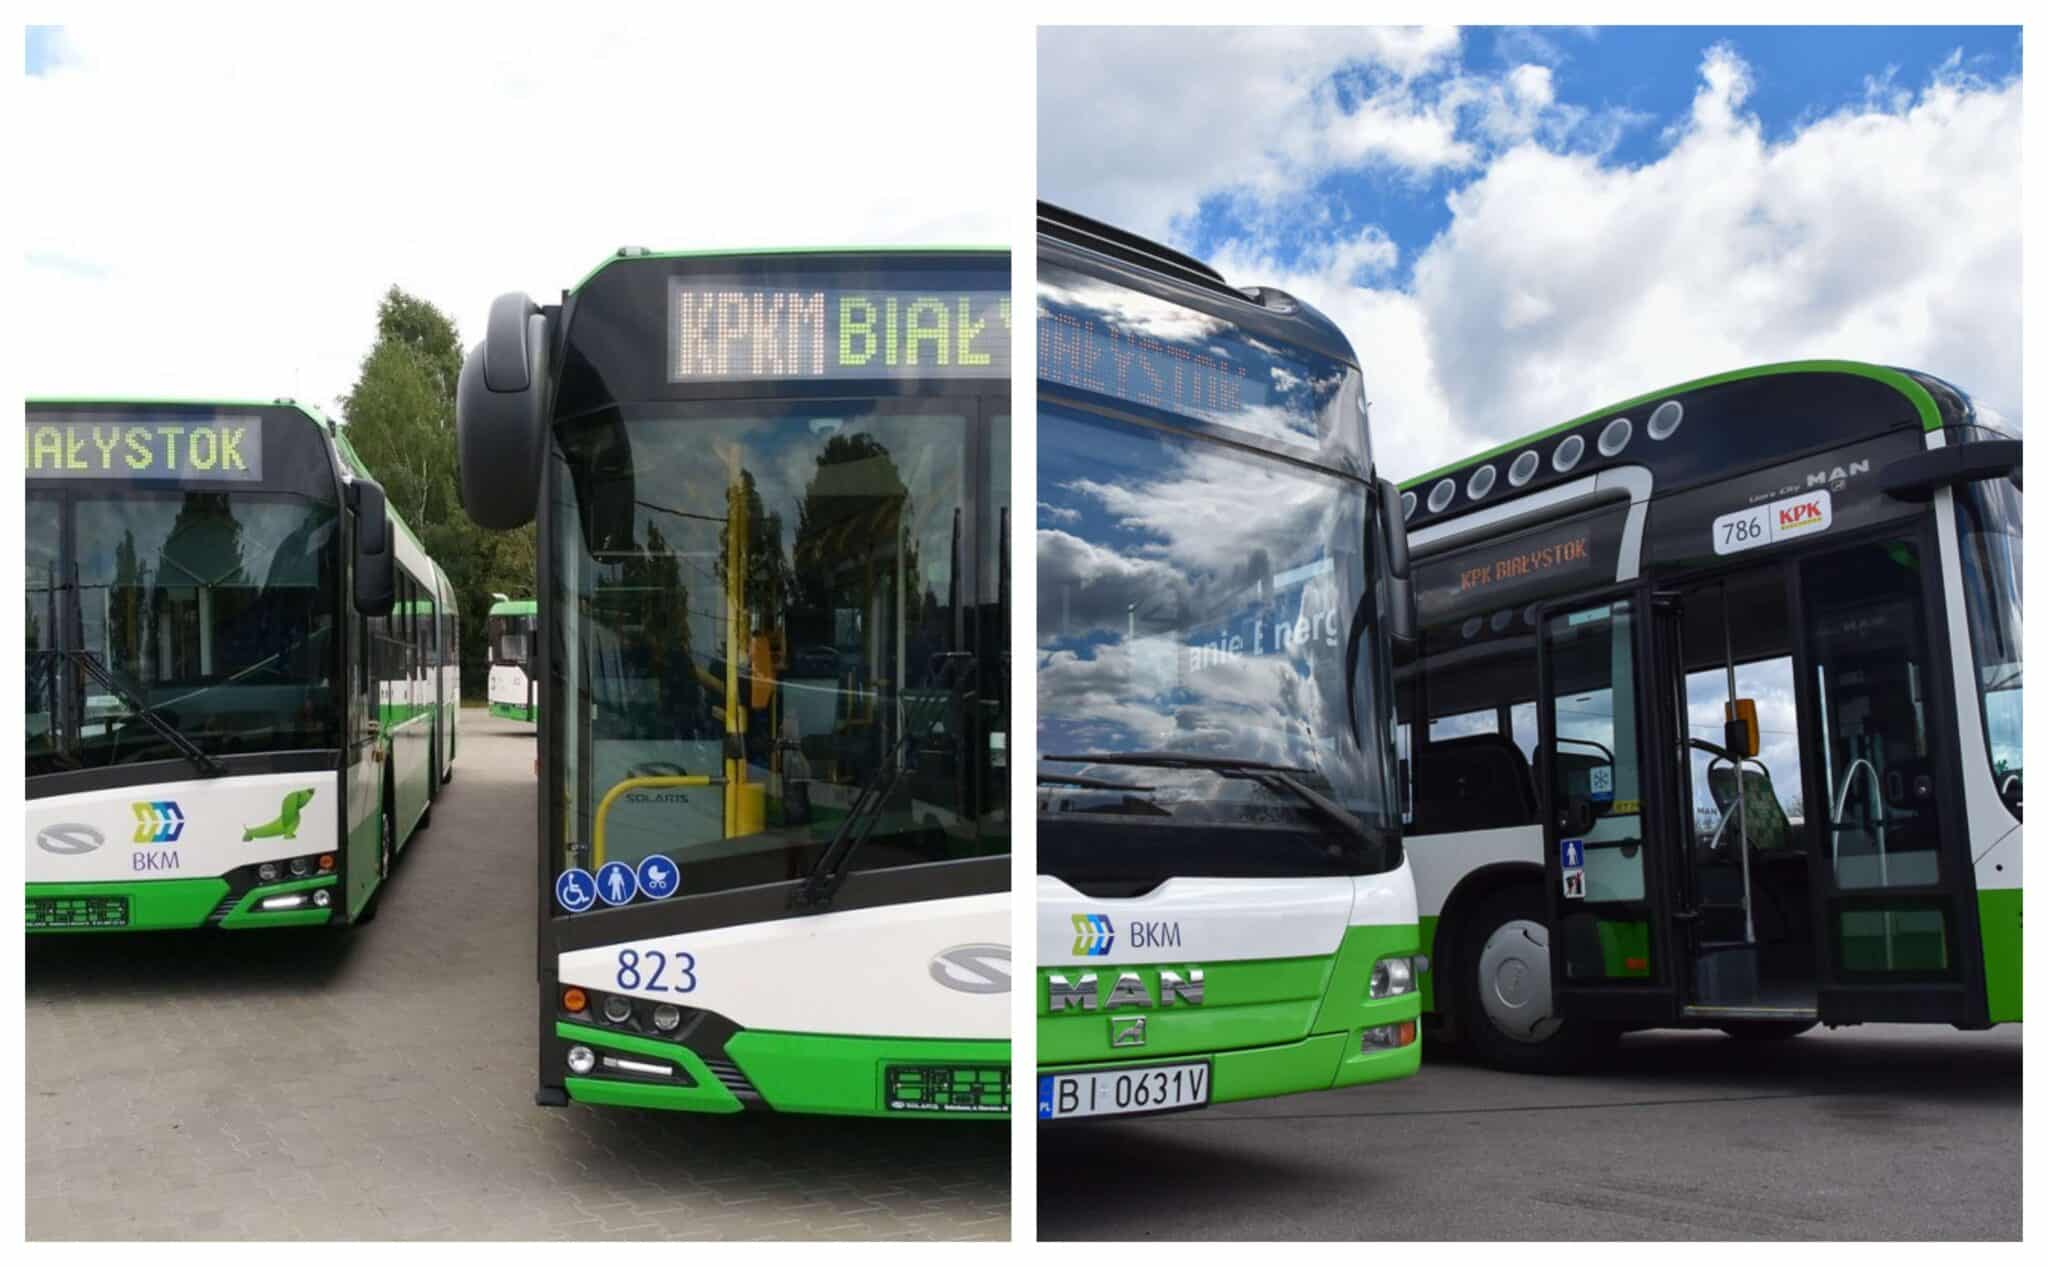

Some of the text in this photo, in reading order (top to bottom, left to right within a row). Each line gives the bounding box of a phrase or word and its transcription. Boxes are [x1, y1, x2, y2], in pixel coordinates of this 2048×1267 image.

[680, 292, 824, 375] KPKM
[1806, 459, 1870, 487] MAN
[1779, 501, 1821, 525] KPK
[1722, 516, 1762, 545] 786
[1460, 564, 1492, 592] KPK
[133, 850, 181, 872] BKM
[1130, 921, 1182, 949] BKM
[616, 949, 698, 993] 823
[1048, 969, 1205, 1011] MAN
[1058, 1077, 1097, 1114] BI
[1115, 1068, 1205, 1109] 0631V
